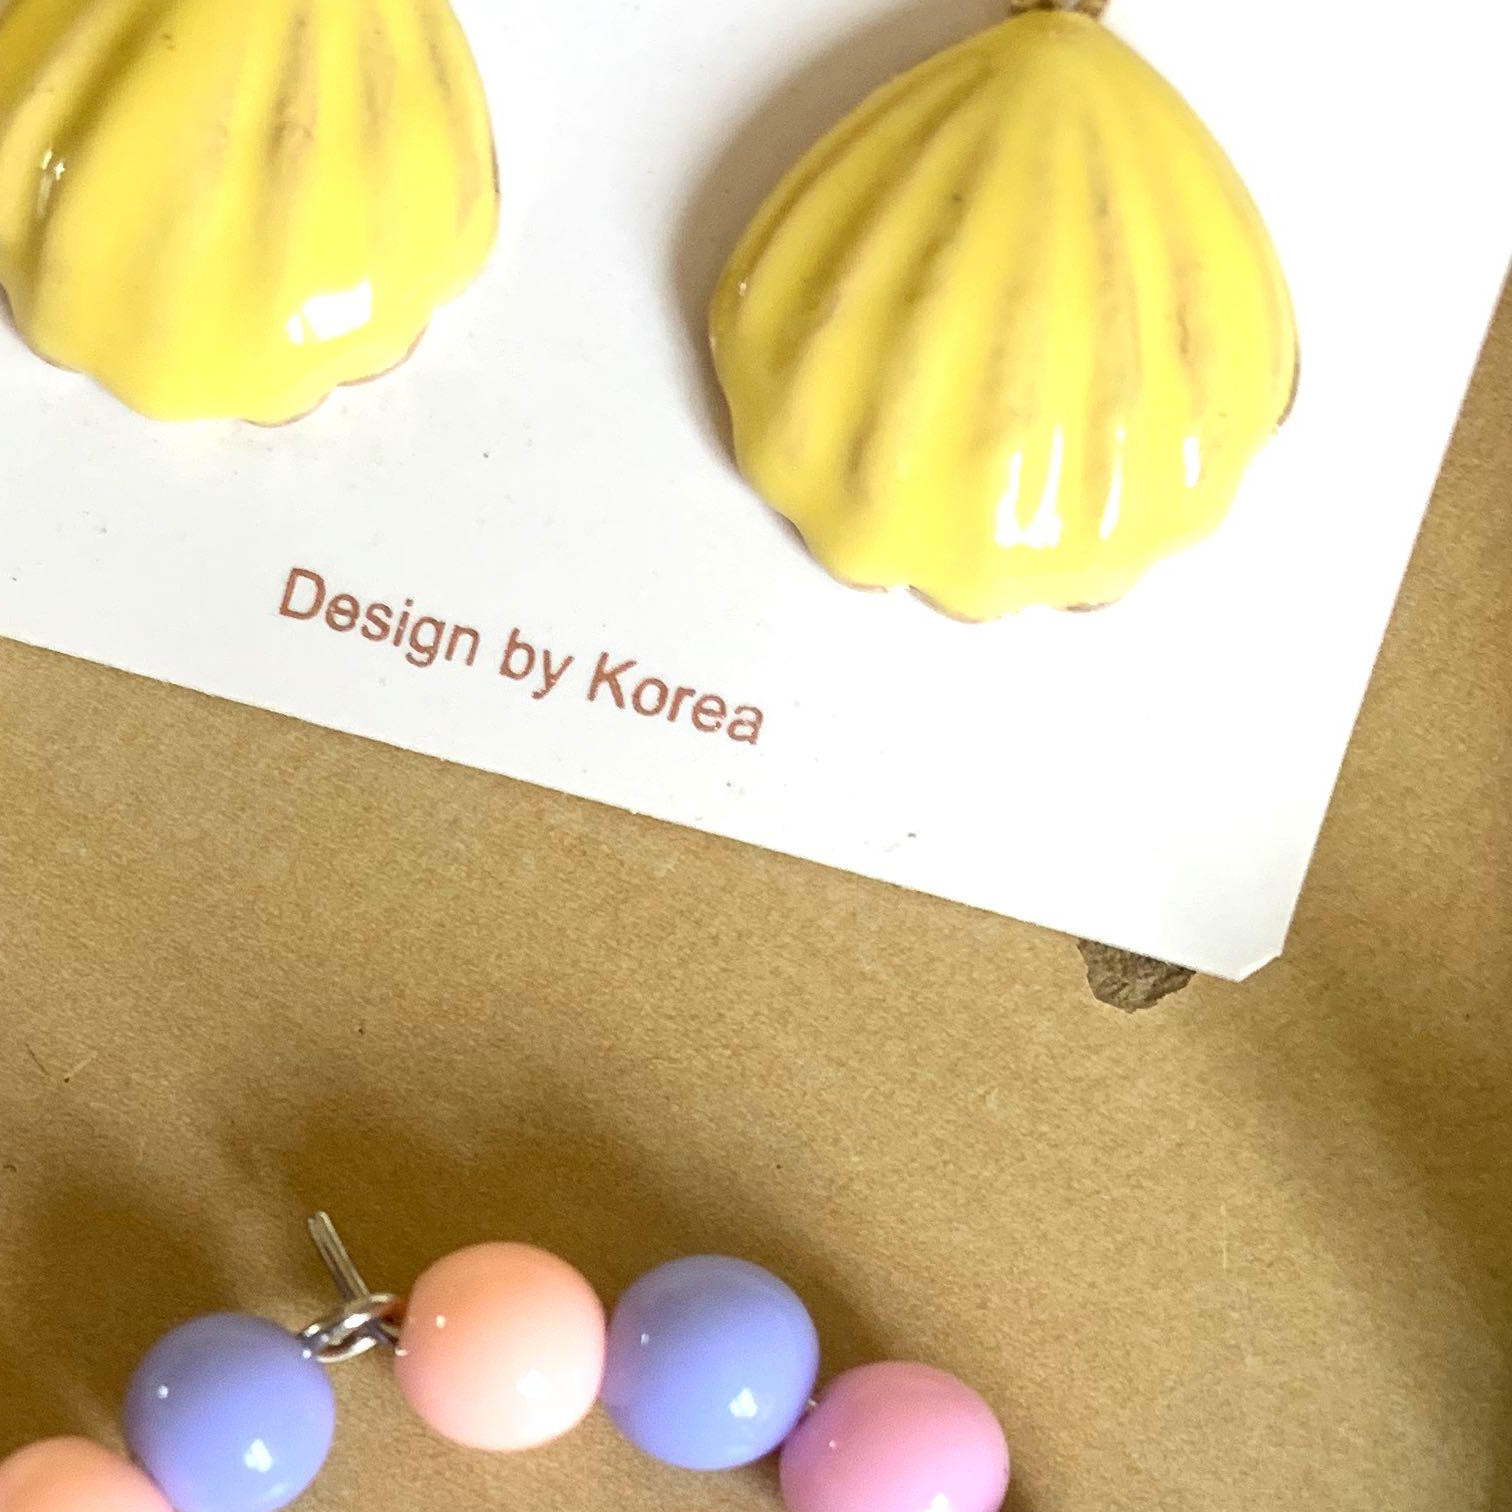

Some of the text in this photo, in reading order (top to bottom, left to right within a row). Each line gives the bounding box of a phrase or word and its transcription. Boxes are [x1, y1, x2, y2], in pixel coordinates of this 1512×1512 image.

[279, 567, 764, 745] Design by Korea
